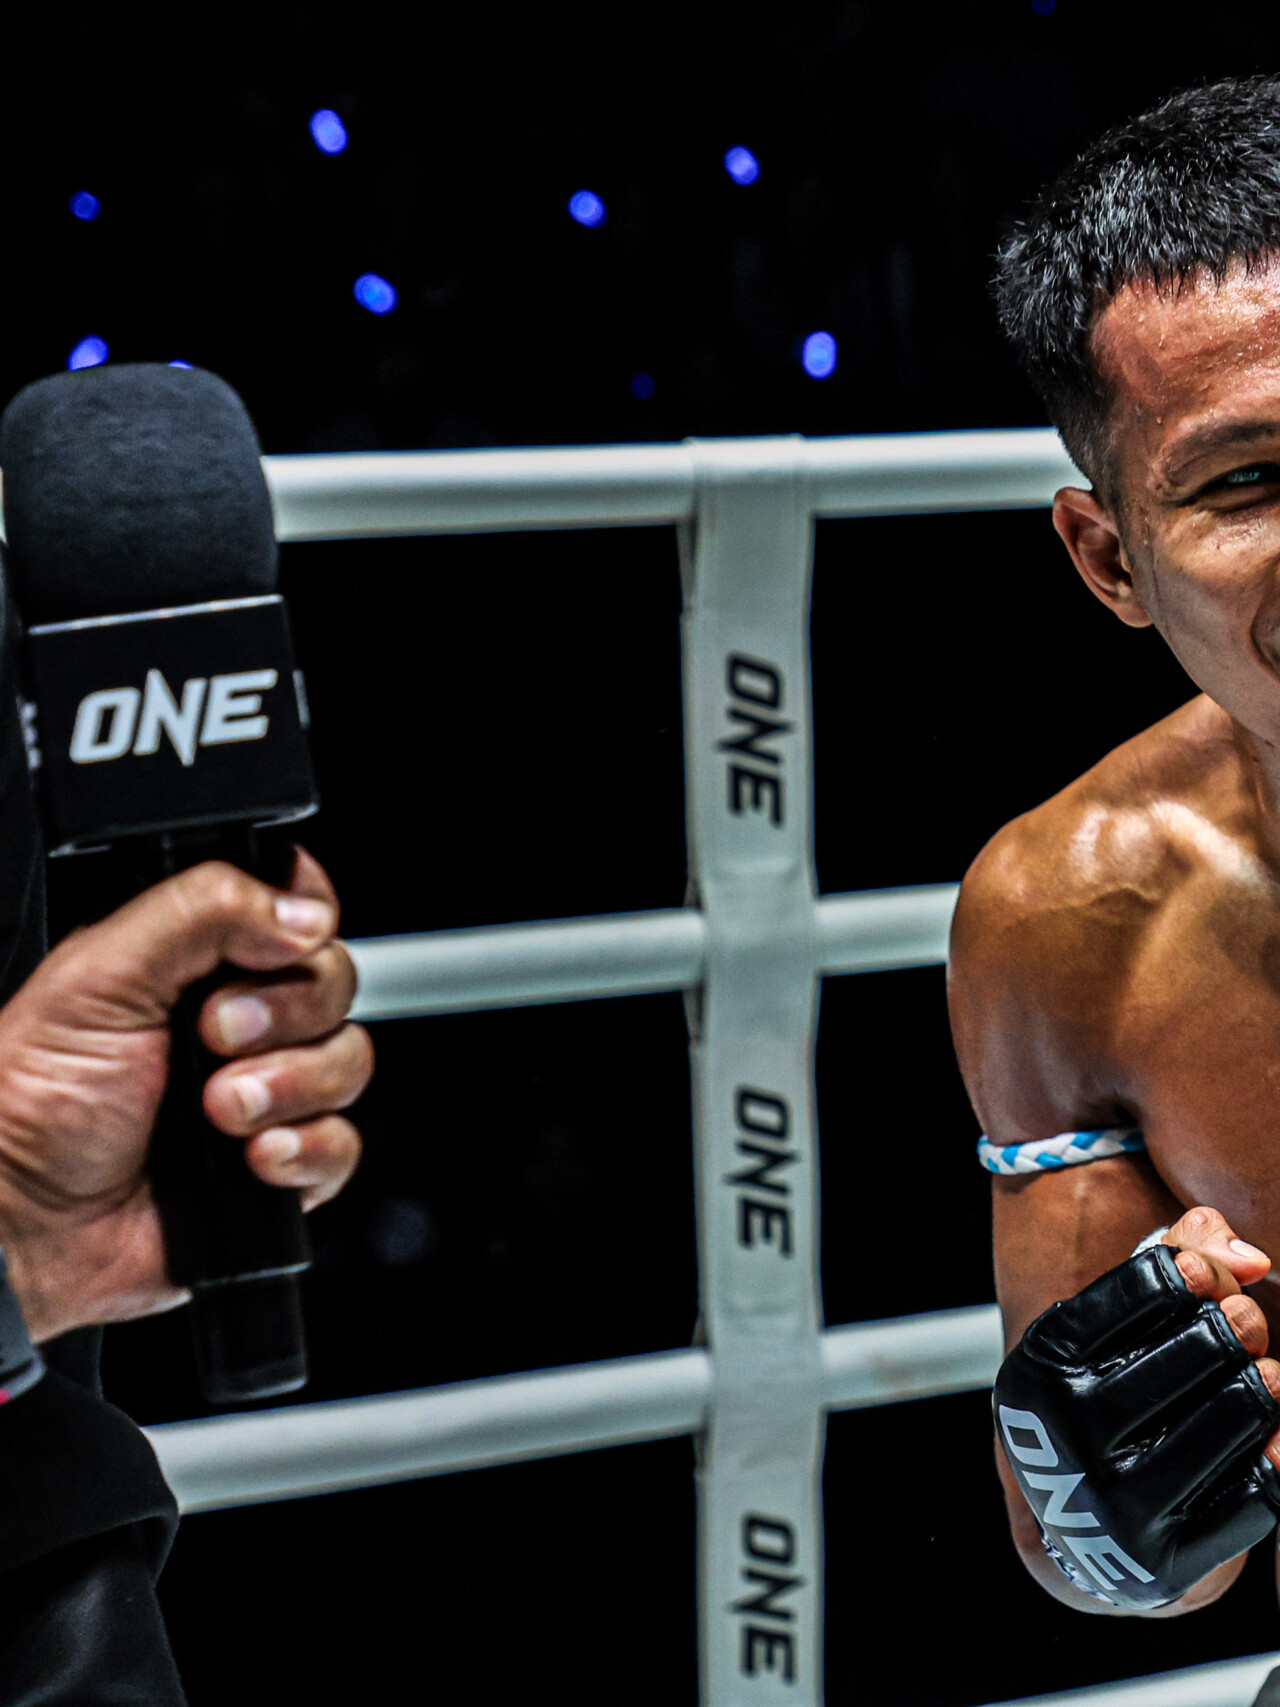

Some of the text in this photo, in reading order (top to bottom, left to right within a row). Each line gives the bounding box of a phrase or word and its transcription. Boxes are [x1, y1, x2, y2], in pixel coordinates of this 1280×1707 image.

[69, 668, 278, 767] ONE
[715, 652, 795, 829] ONE
[723, 1086, 800, 1258] ONE
[999, 1404, 1155, 1591] ONE
[729, 1513, 805, 1684] ONE
